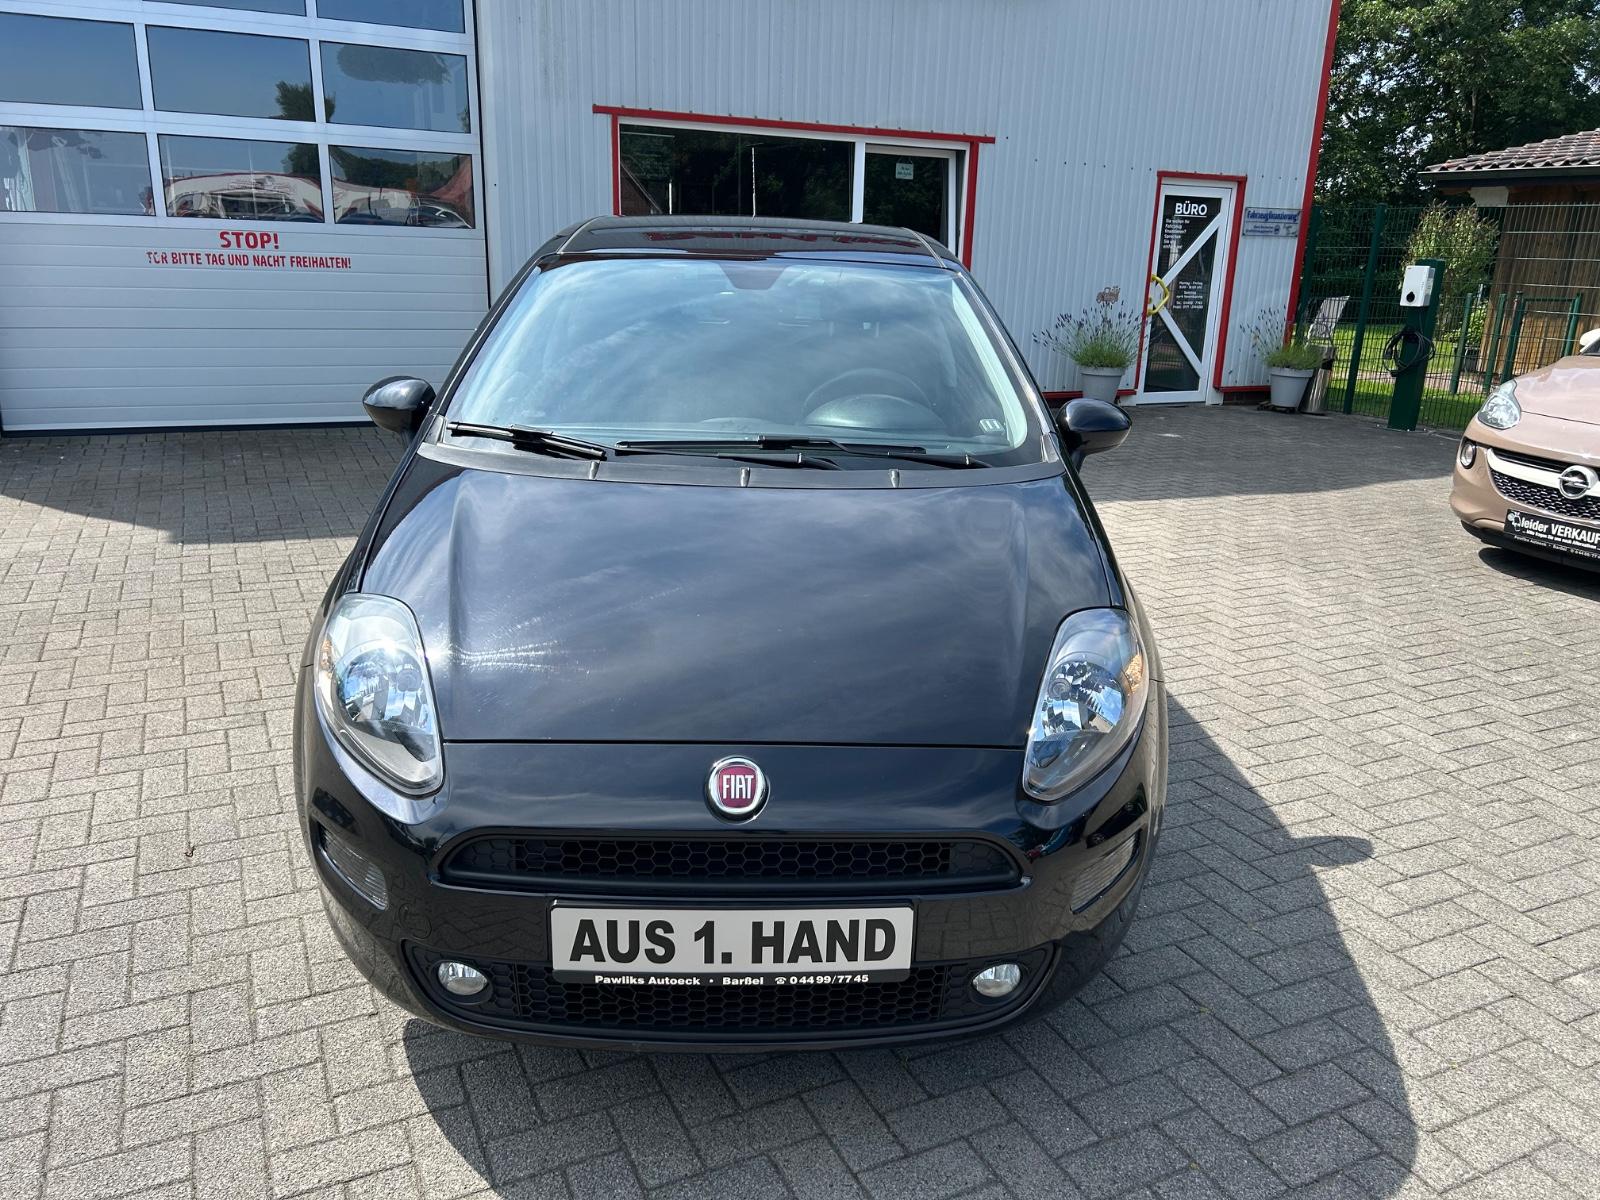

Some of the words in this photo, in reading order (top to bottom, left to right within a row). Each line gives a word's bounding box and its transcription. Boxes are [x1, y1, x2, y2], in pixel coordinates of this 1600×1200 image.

[1175, 200, 1207, 215] BÜRO
[220, 231, 279, 249] STOP!
[171, 252, 203, 265] BITTE
[205, 253, 225, 265] TAG
[228, 254, 249, 266] UND
[253, 254, 286, 267] NACHT
[290, 255, 351, 269] FREIHALTEN!
[1521, 517, 1549, 533] leider
[722, 774, 754, 799] FIAT
[569, 919, 676, 964] AUS
[694, 920, 732, 964] 1.
[751, 919, 896, 964] HAND
[595, 975, 645, 985] Pawliks
[648, 976, 700, 985] Autoeck
[722, 976, 764, 985] Barßel
